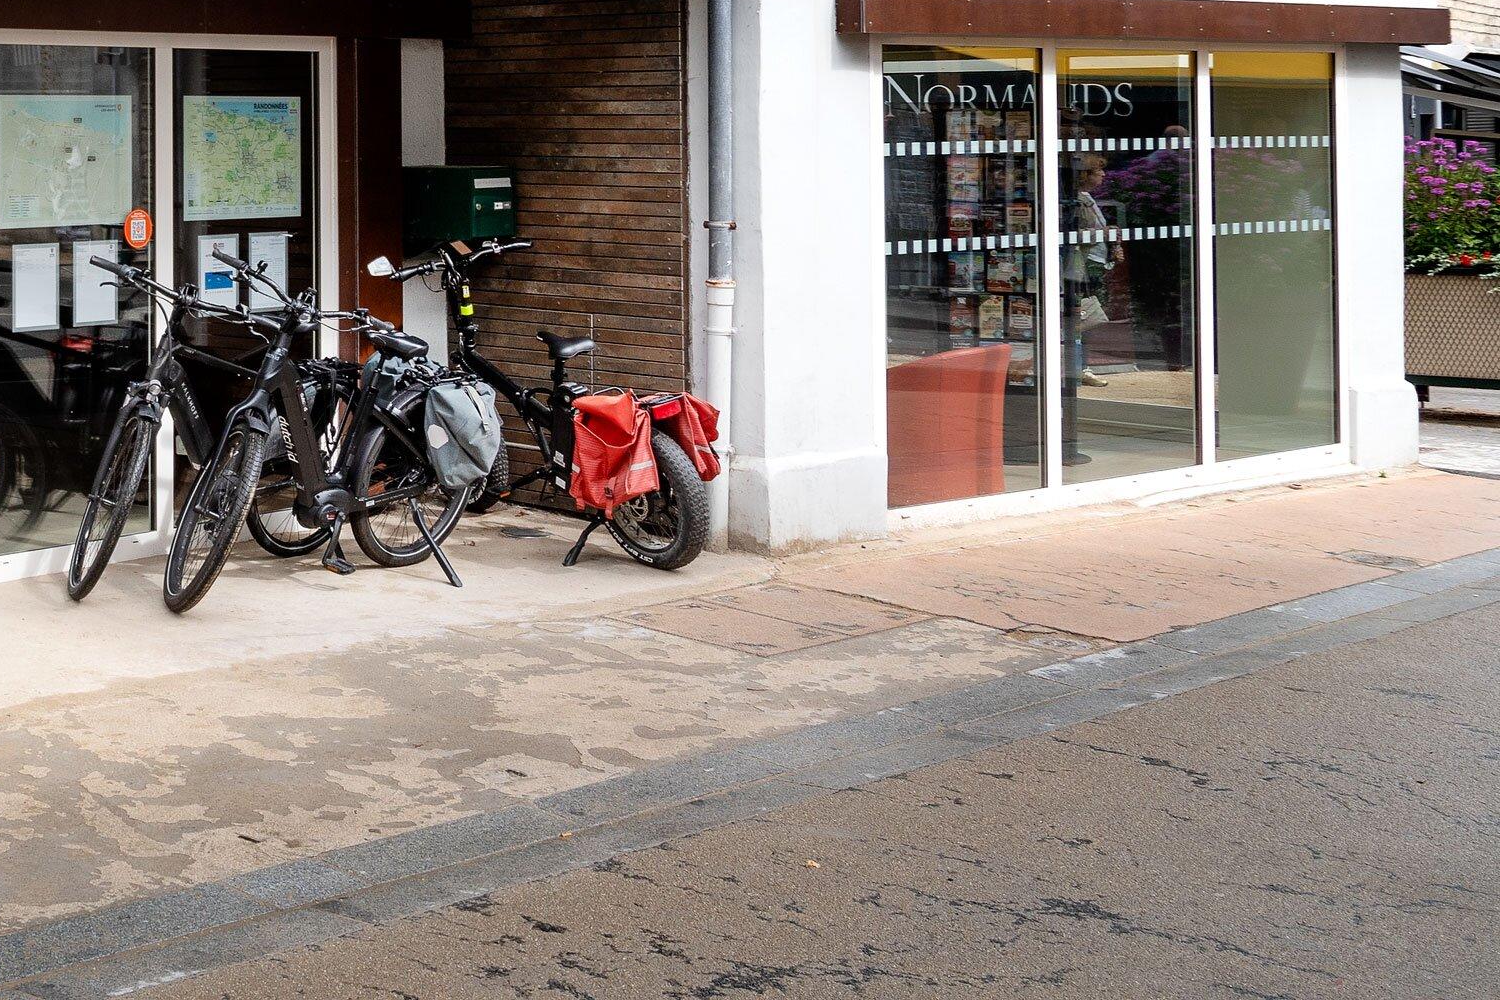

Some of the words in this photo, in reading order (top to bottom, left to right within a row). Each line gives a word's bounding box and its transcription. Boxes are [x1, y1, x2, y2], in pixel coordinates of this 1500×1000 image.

[884, 74, 1133, 117] NORMADS
[181, 382, 199, 419] KALKHOFF
[278, 414, 295, 449] dutch
[287, 450, 299, 463] id
